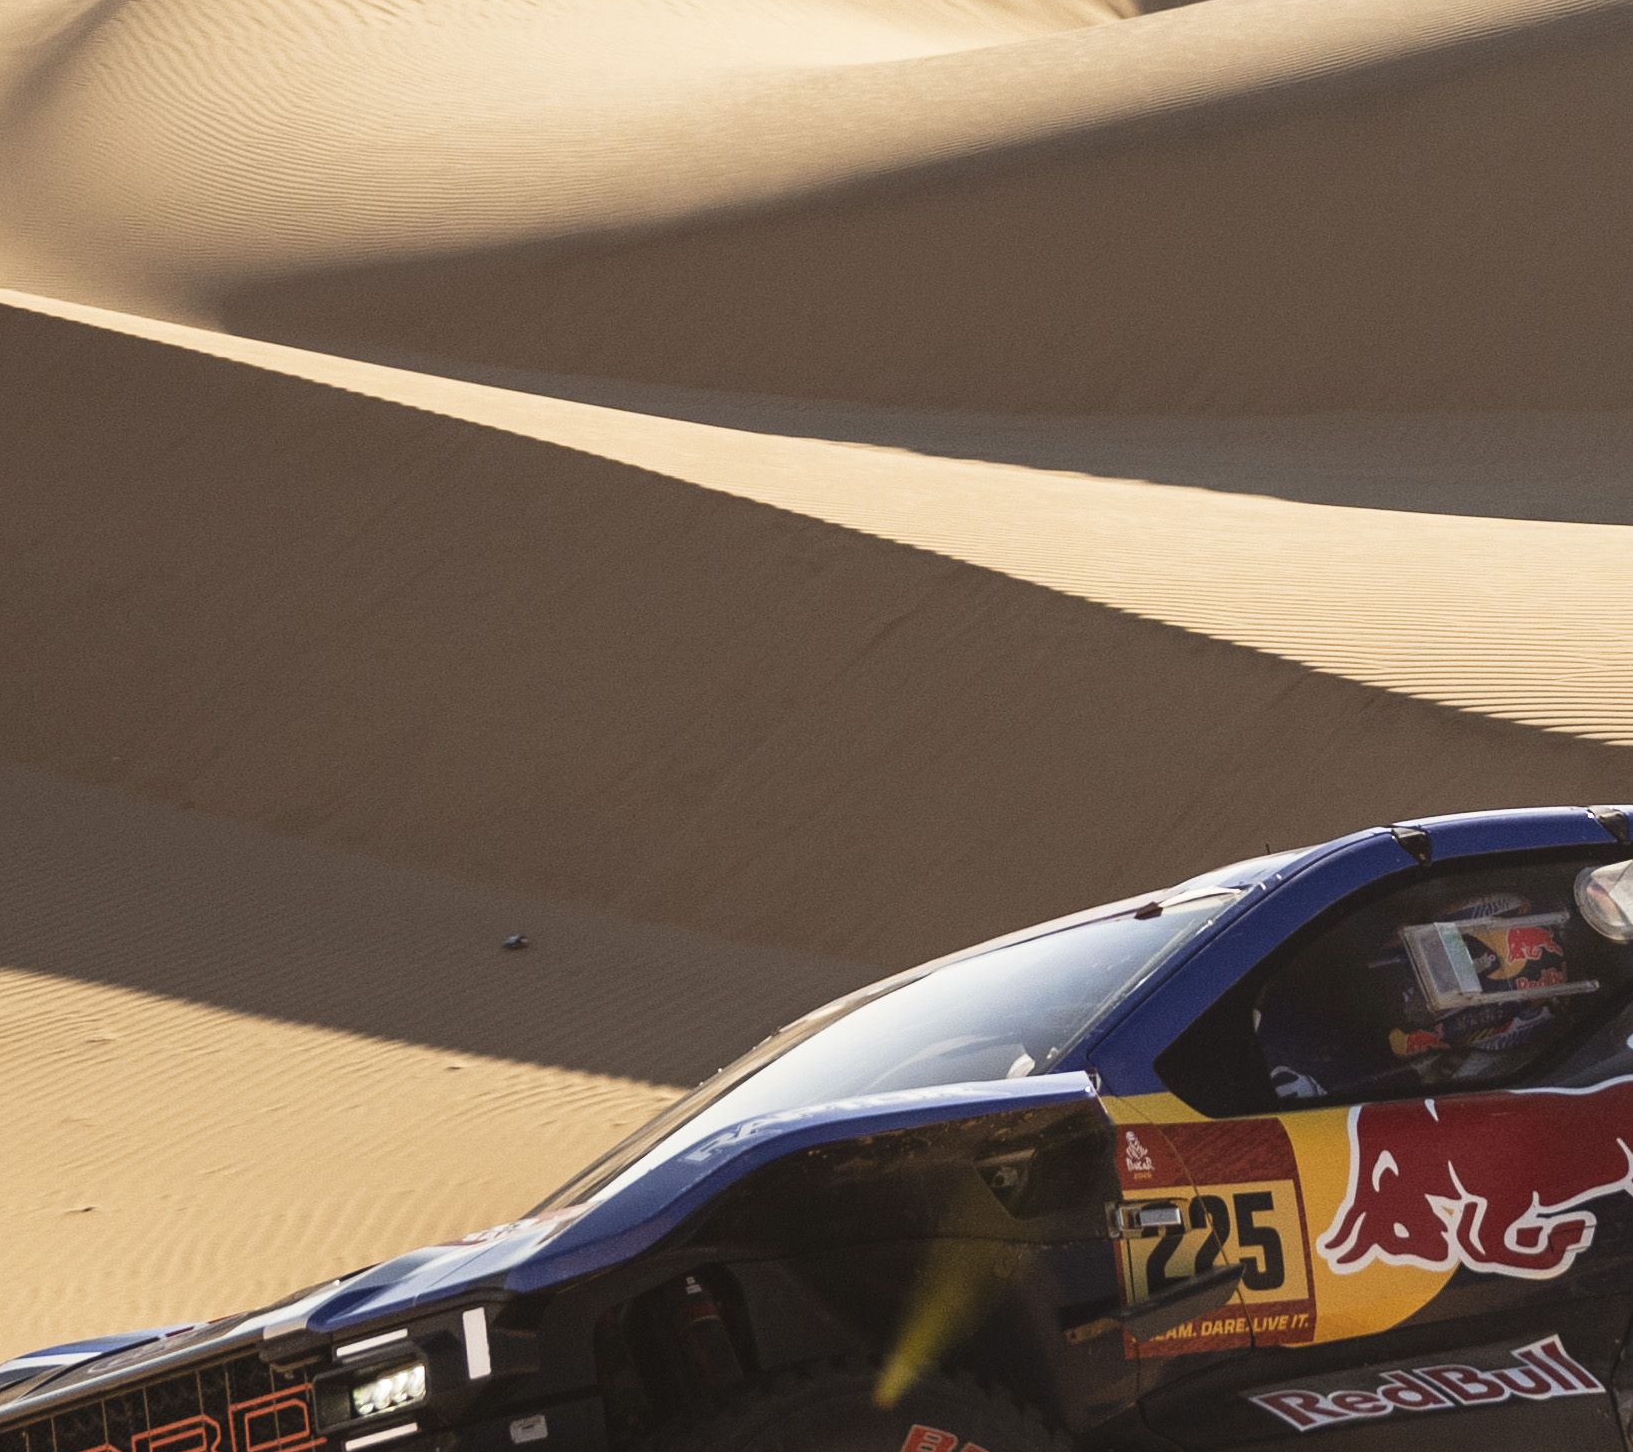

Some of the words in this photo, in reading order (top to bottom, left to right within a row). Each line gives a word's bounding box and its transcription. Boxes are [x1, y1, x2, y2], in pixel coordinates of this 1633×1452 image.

[1141, 1191, 1285, 1296] 225
[1201, 1318, 1249, 1337] DARE.
[1253, 1315, 1291, 1333] LIVE
[1291, 1313, 1309, 1329] IT.
